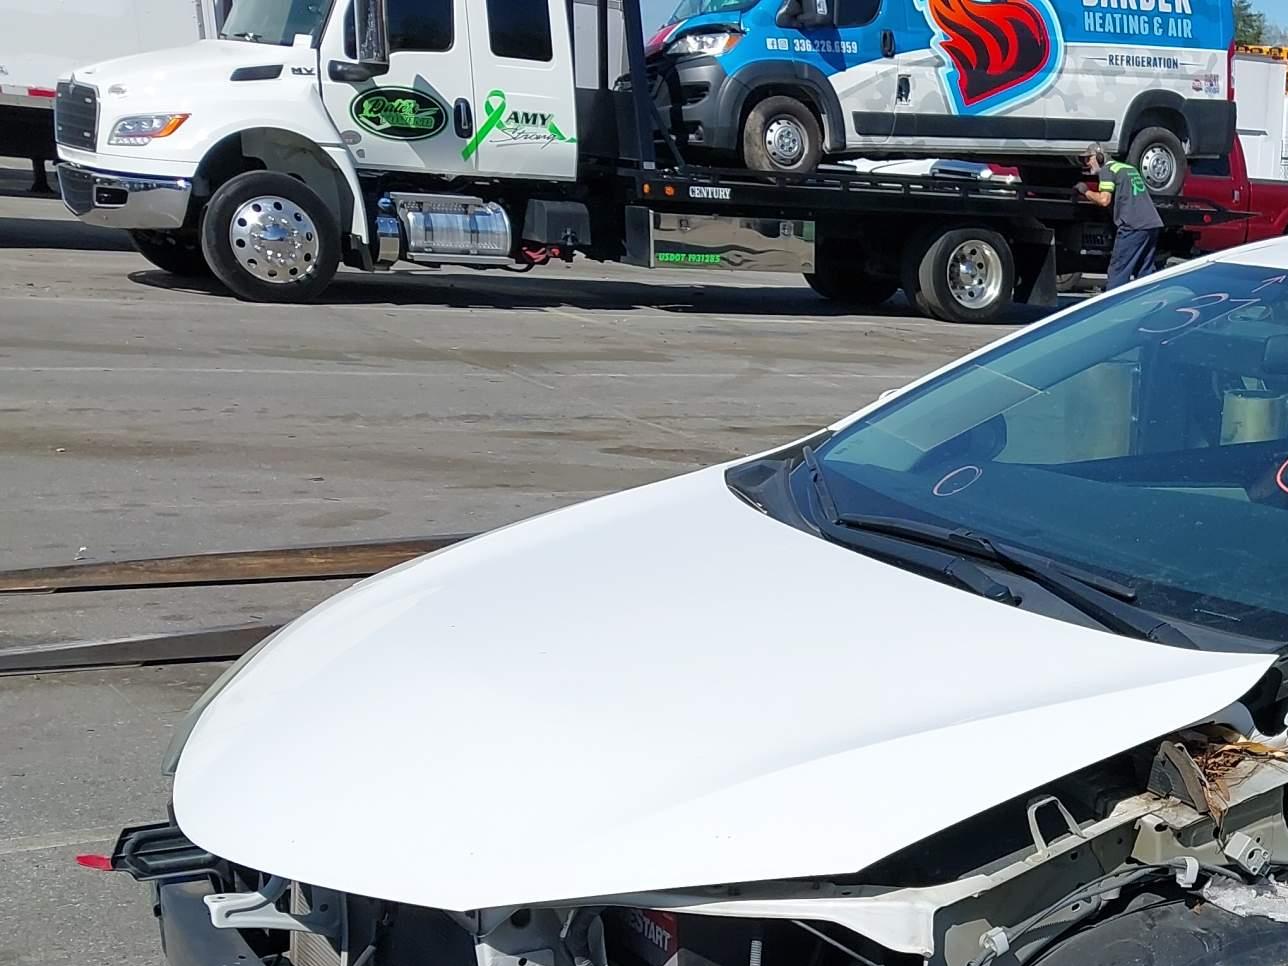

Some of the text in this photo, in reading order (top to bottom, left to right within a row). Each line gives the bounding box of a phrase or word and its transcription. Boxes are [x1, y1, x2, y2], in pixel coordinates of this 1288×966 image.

[1084, 12, 1192, 38] HEATING & AIR
[1108, 54, 1178, 69] REFRIGERATION
[505, 111, 553, 126] AMY
[489, 127, 557, 150] Strong
[689, 186, 731, 199] CENTURY
